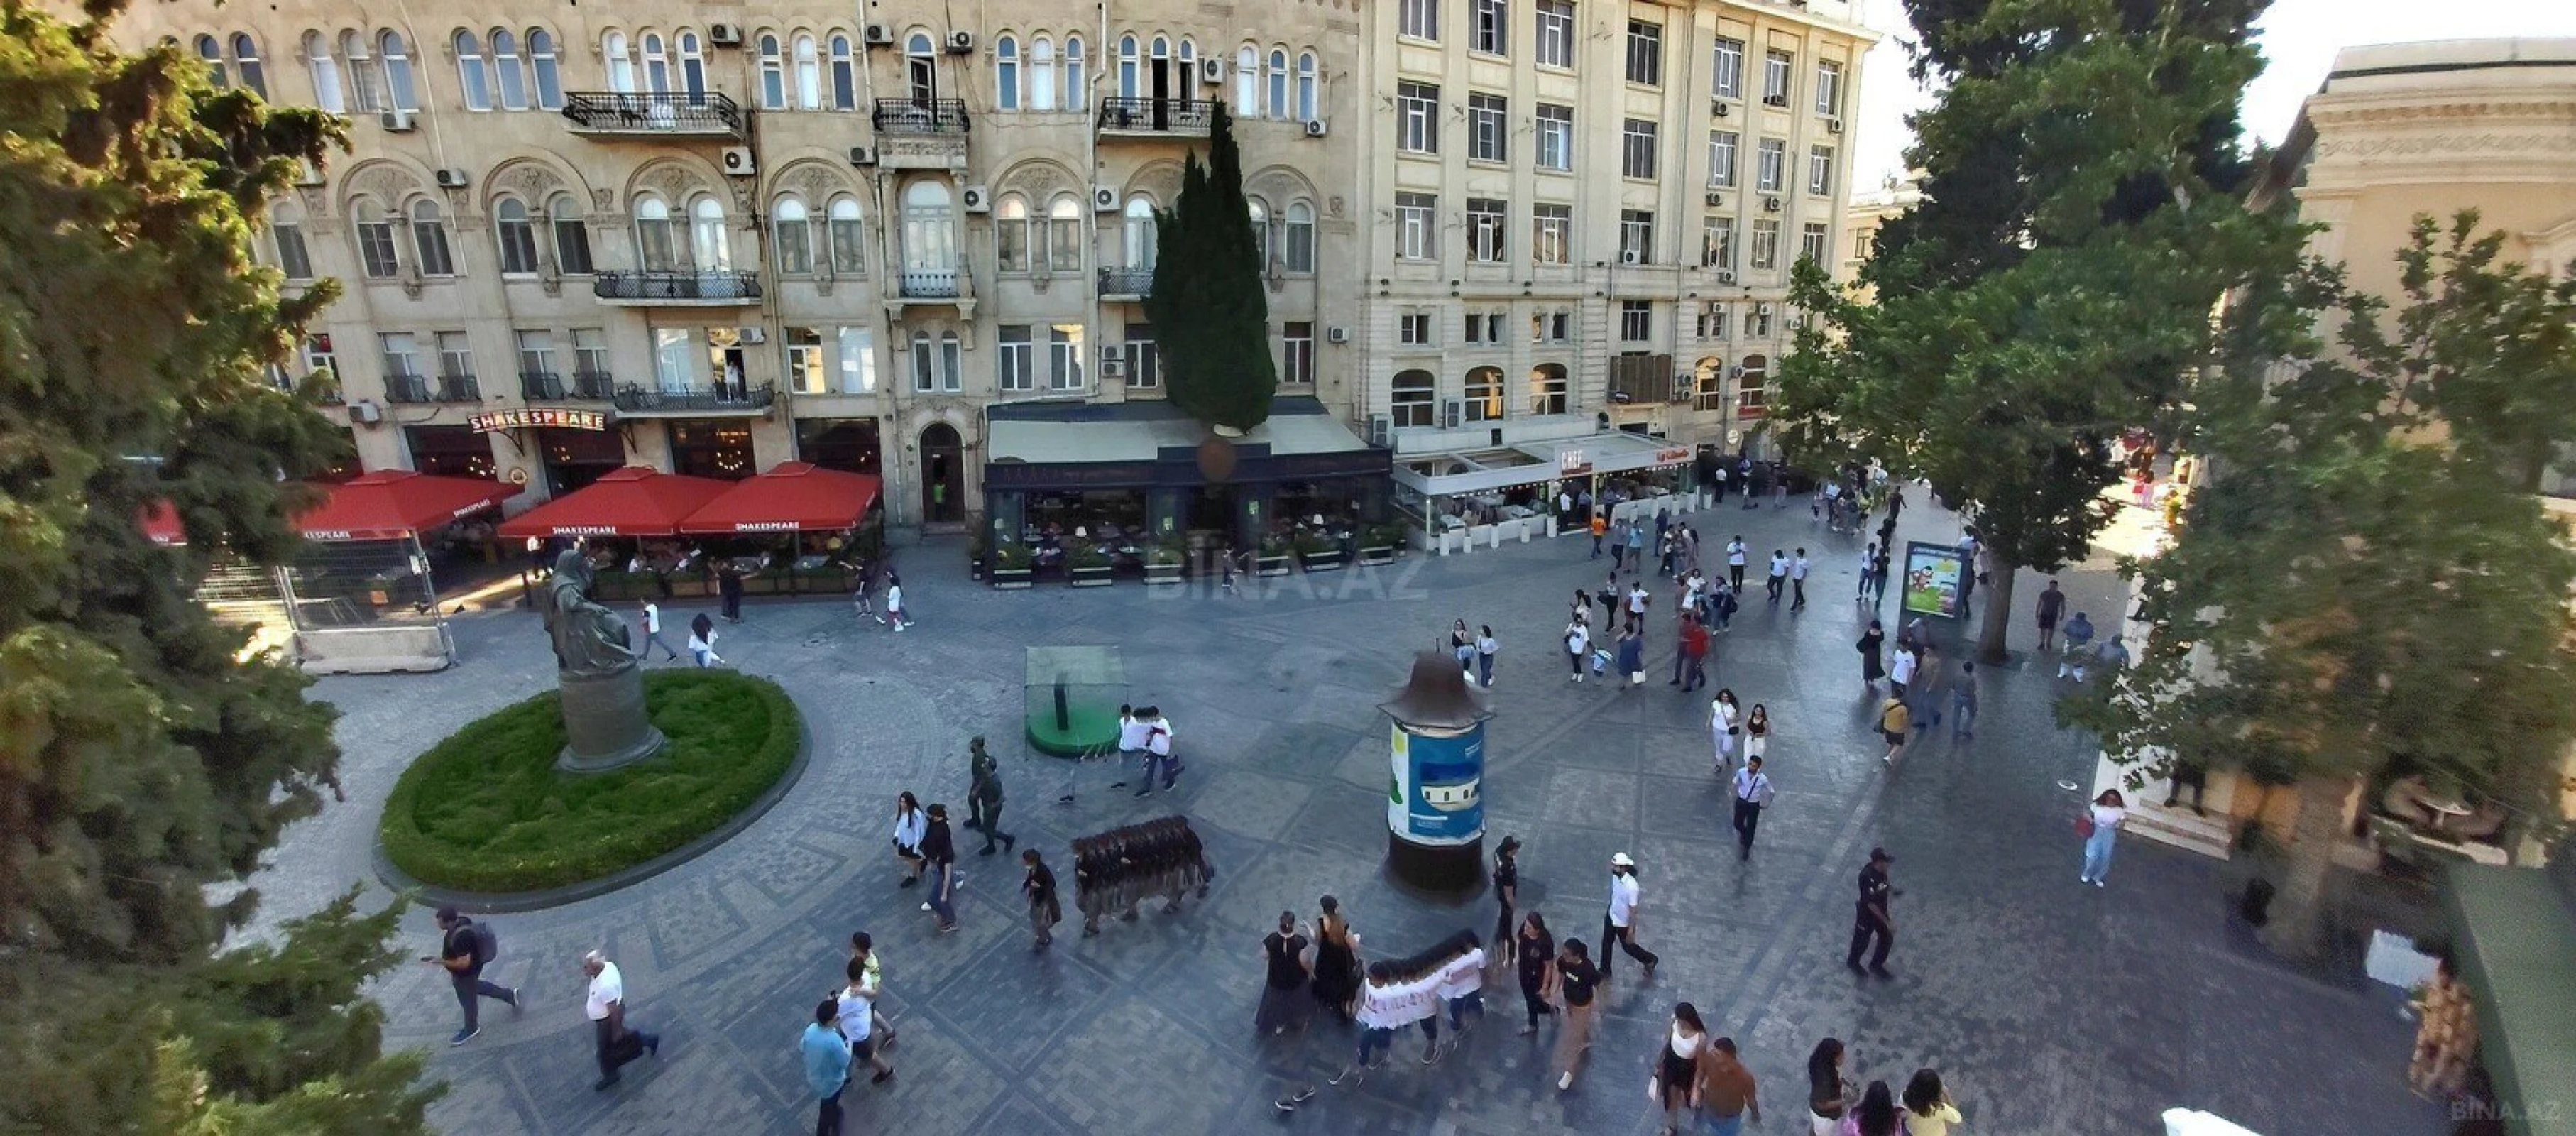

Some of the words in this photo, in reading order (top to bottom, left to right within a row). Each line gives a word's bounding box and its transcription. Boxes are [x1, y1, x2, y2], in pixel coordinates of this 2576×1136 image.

[470, 410, 605, 430] SHAKESPEARE
[552, 525, 617, 535] SHAKESPEARE
[735, 521, 799, 531] SHAKESPEARE
